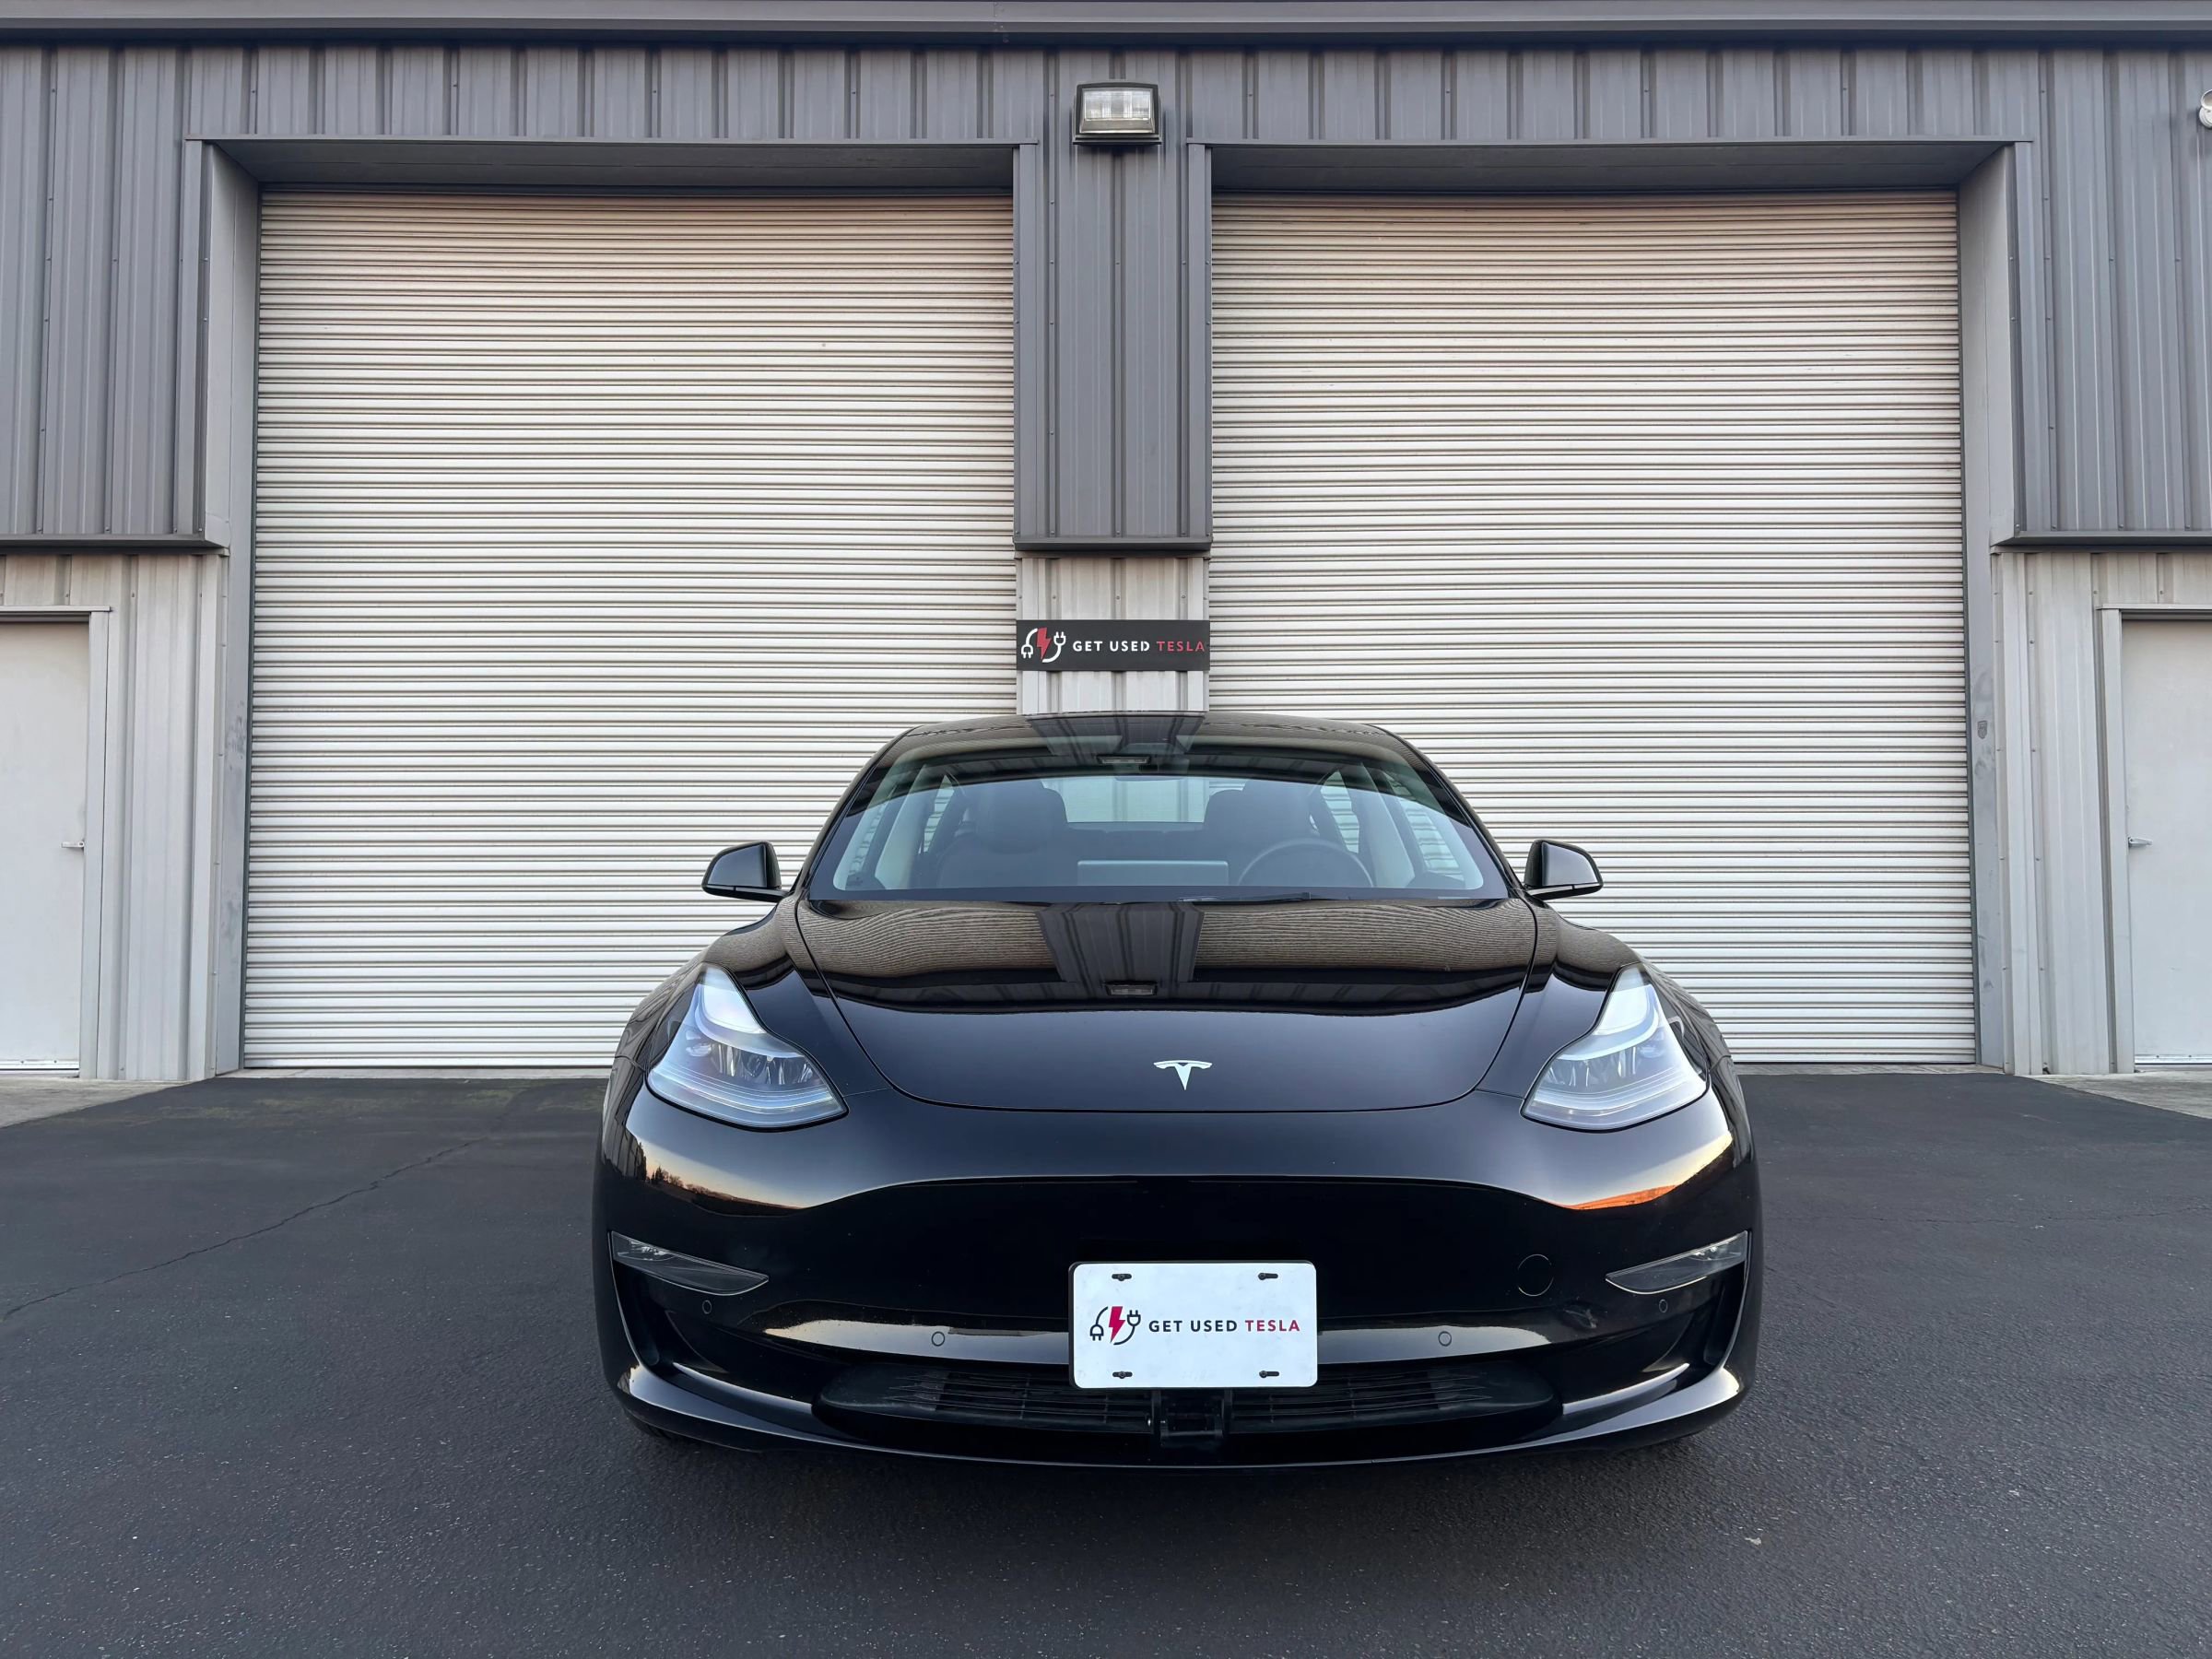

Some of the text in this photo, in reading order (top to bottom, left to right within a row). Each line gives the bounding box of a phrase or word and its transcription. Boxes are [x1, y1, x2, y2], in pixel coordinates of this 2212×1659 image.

[1072, 641, 1205, 653] GET USED TESLA
[1148, 1319, 1300, 1333] GET USED TESLA
